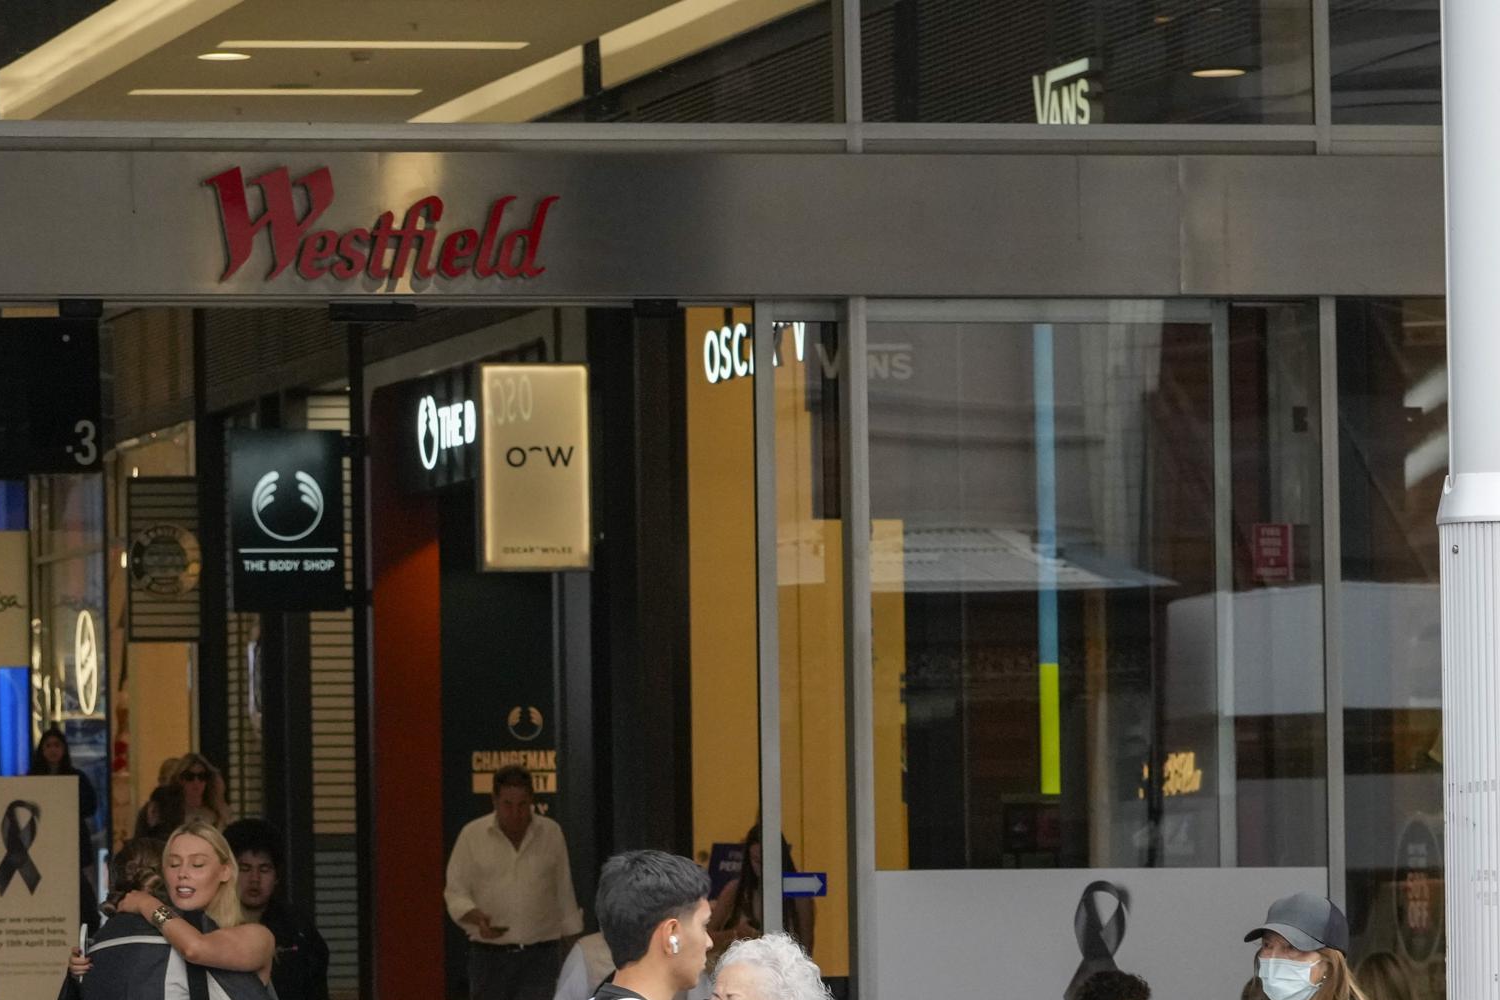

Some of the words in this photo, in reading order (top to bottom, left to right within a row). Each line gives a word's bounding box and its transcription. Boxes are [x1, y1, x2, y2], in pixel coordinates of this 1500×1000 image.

[1032, 57, 1091, 125] VANS
[202, 166, 560, 282] Westfield
[437, 403, 464, 450] THE
[243, 560, 267, 571] THE
[268, 560, 300, 571] BODY
[303, 560, 335, 571] SHOP
